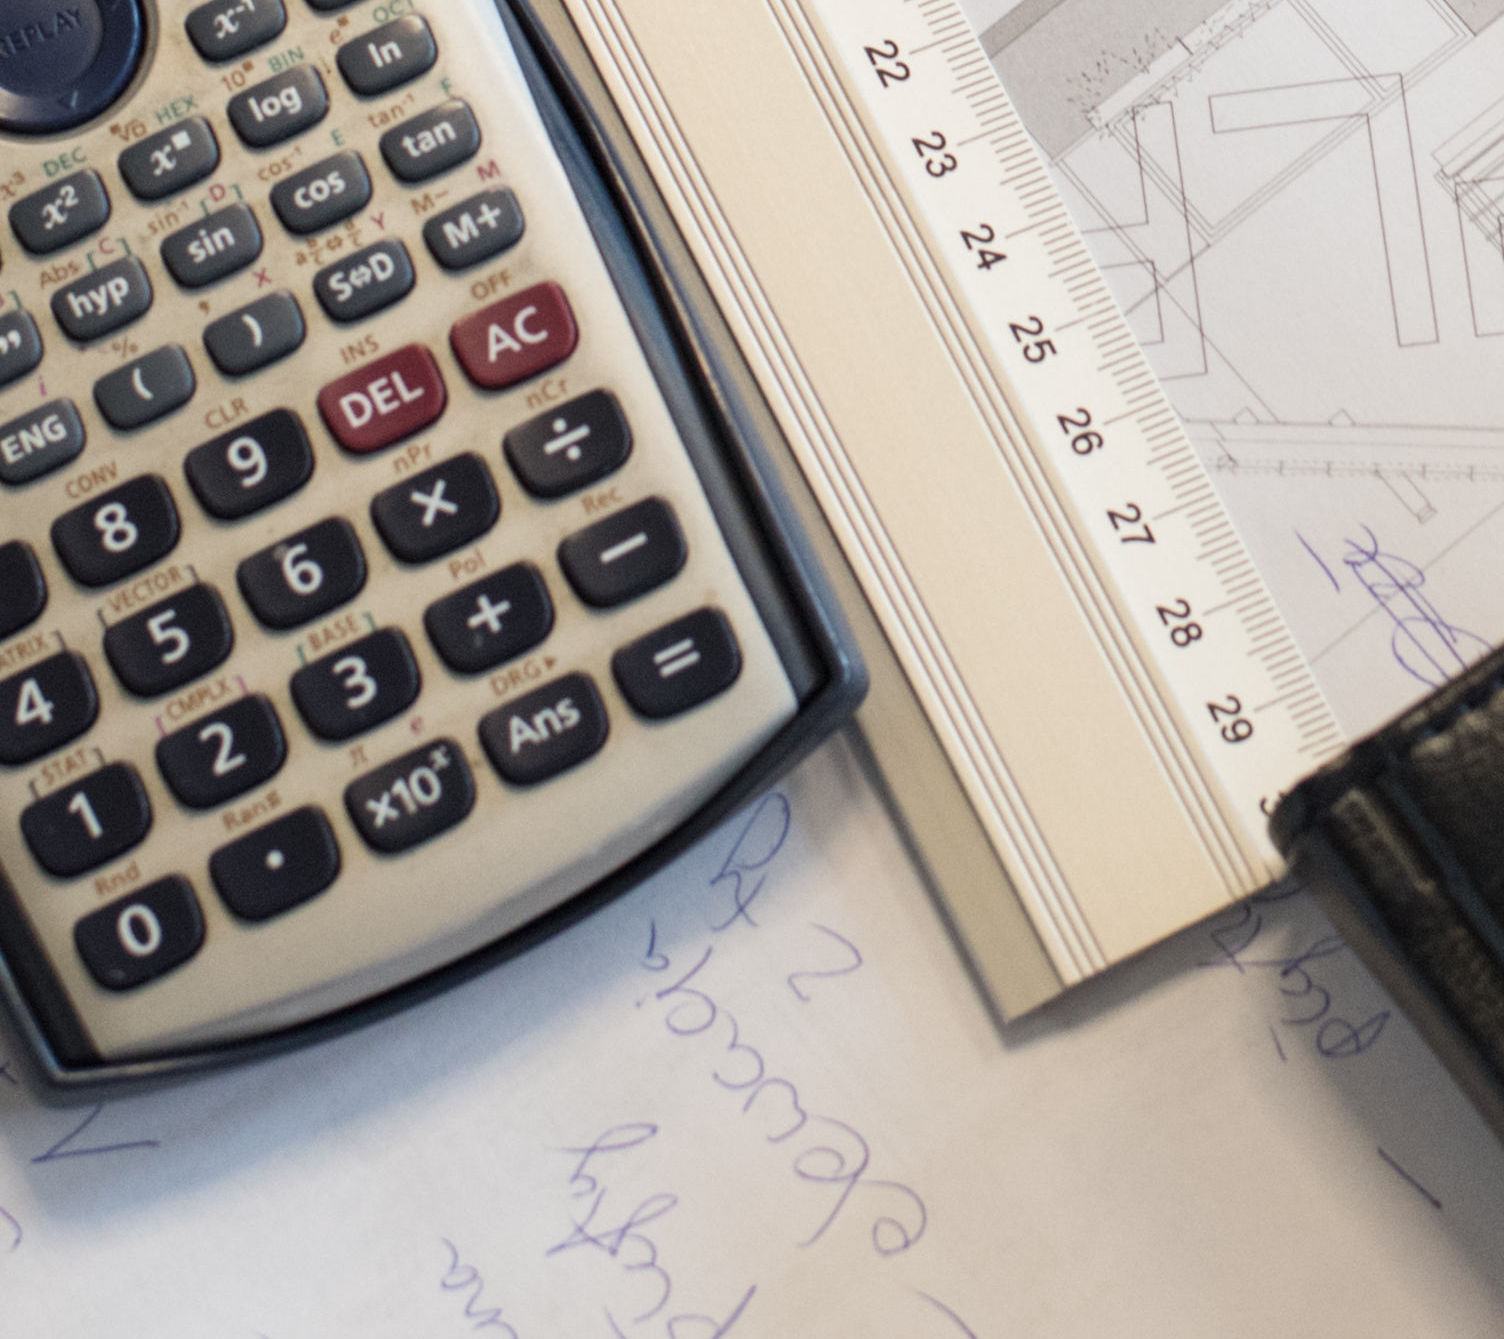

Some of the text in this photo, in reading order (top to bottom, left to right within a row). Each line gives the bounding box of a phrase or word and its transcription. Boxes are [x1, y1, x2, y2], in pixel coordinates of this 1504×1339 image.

[367, 40, 403, 69] ln
[864, 37, 912, 90] 22
[400, 120, 458, 159] tan
[293, 169, 347, 209] cos
[187, 225, 236, 264] sin
[958, 222, 1007, 272] 24
[66, 275, 130, 320] hyp
[486, 305, 549, 364] AC
[338, 370, 425, 429] DEL
[0, 413, 68, 465] ENG
[1056, 406, 1105, 457] 26
[225, 435, 269, 488] 9
[94, 501, 139, 553] 8
[106, 565, 183, 613] VECTOR
[281, 543, 324, 596] 6
[146, 608, 191, 664] 5
[307, 613, 360, 652] BASE
[1156, 597, 1204, 649] 28
[14, 677, 55, 726] 4
[165, 678, 234, 722] CMPLX
[331, 655, 377, 711] 3
[199, 722, 247, 777] 2
[506, 696, 581, 754] Ans
[40, 748, 89, 787] STAT
[67, 790, 104, 839] 1
[116, 903, 164, 957] 0
